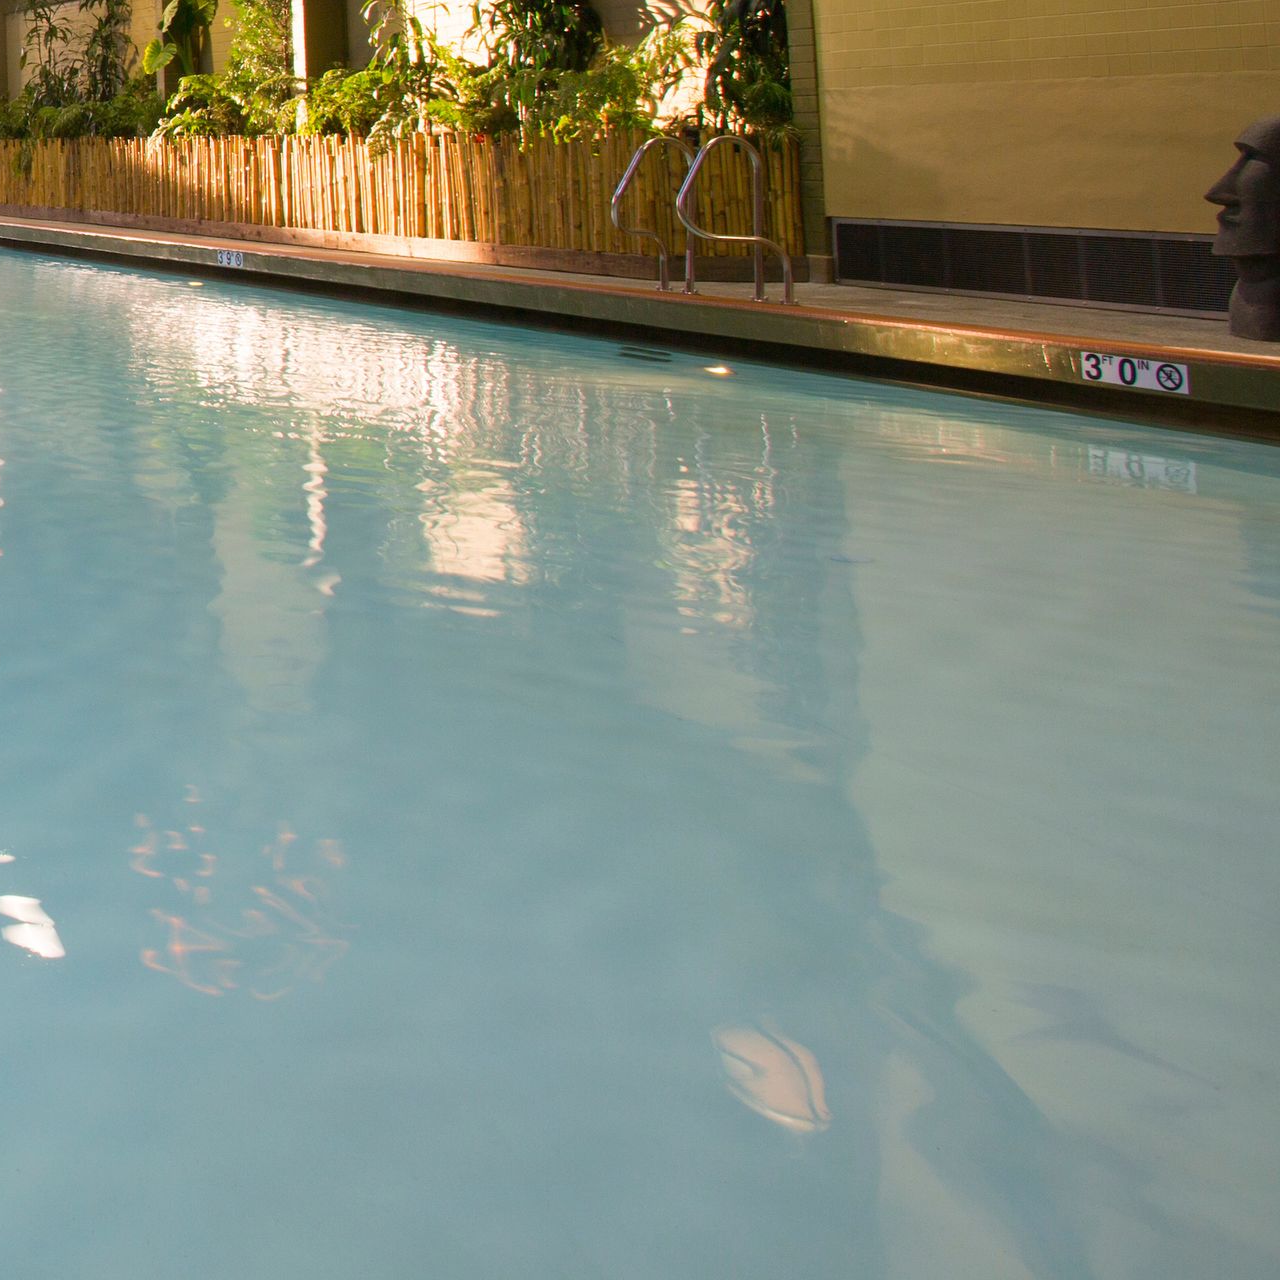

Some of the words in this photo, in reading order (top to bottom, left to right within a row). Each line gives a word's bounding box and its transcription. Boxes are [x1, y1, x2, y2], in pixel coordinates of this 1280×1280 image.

[1085, 353, 1102, 380] 3
[1101, 355, 1114, 365] FT
[1119, 358, 1137, 385] 0
[1137, 360, 1150, 370] IN
